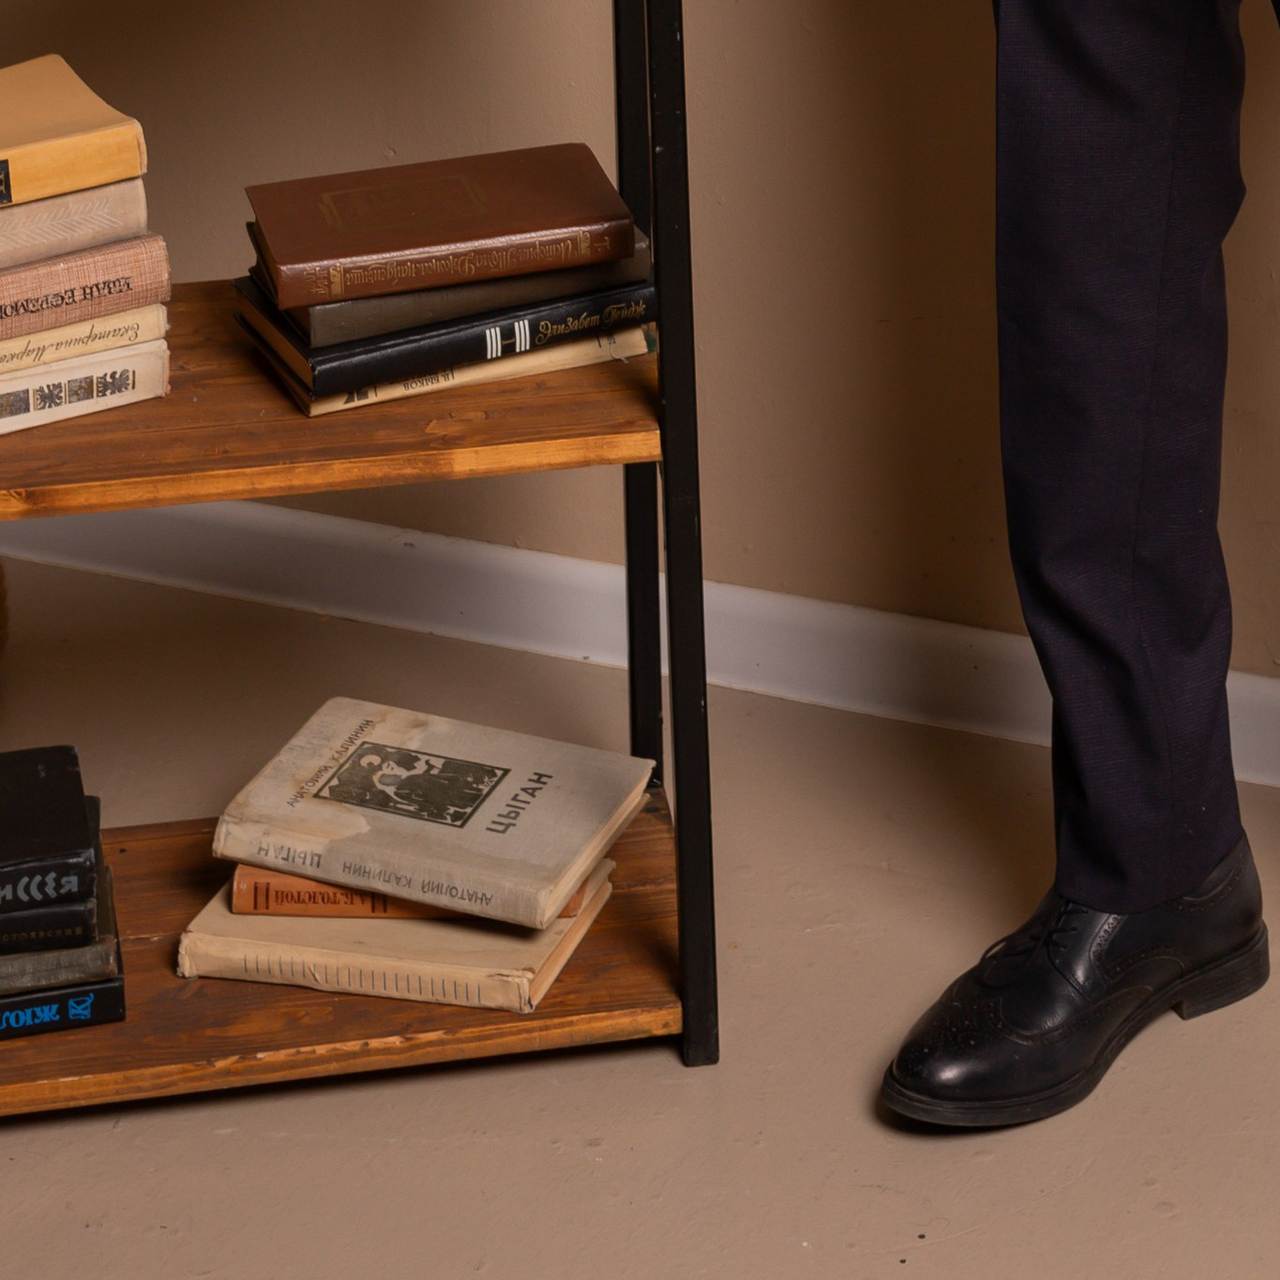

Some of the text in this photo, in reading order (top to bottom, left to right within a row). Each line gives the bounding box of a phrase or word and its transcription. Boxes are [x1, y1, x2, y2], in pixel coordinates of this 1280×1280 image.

[80, 275, 133, 302] ИВАН
[55, 320, 141, 353] Екатерина
[536, 314, 601, 346] Элизабет
[286, 718, 374, 808] АНАТОЛИЙ КАЛИНИН
[485, 771, 554, 835] ЦЫГАН
[256, 843, 494, 906] АНАТОЛИЙ КАЛИНИН ЦЫГАН
